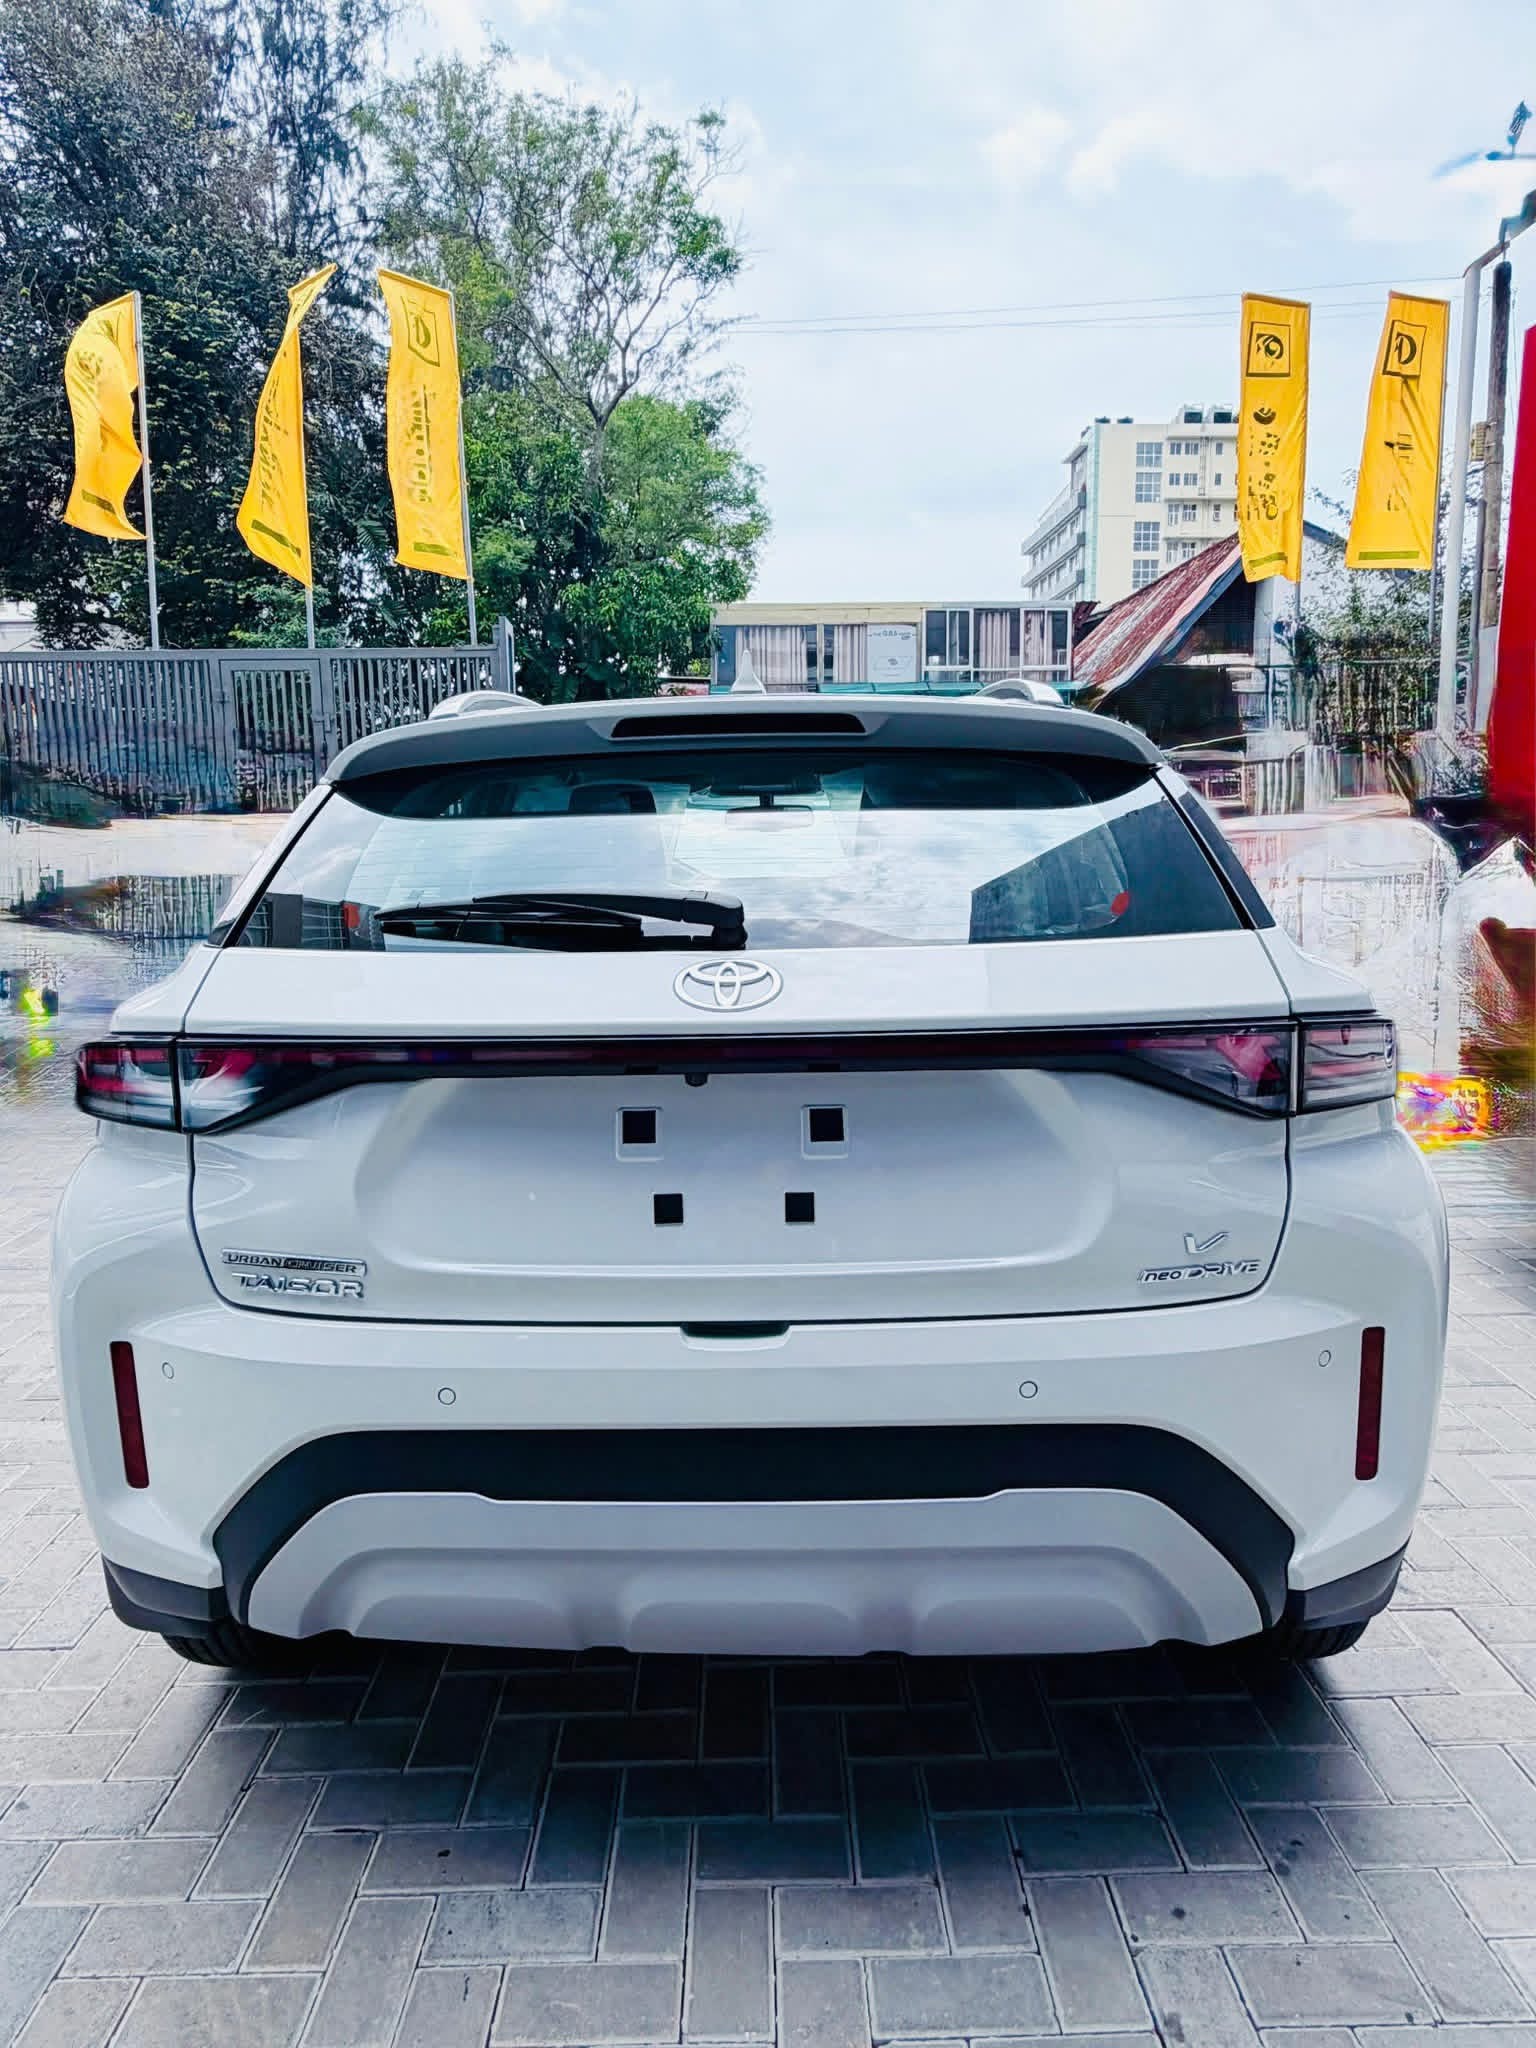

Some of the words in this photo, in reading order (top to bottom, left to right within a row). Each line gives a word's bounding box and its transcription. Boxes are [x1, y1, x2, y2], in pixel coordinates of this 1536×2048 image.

[227, 1253, 282, 1267] URBAN
[285, 1258, 358, 1273] CRUISER
[231, 1272, 365, 1299] TAISOR
